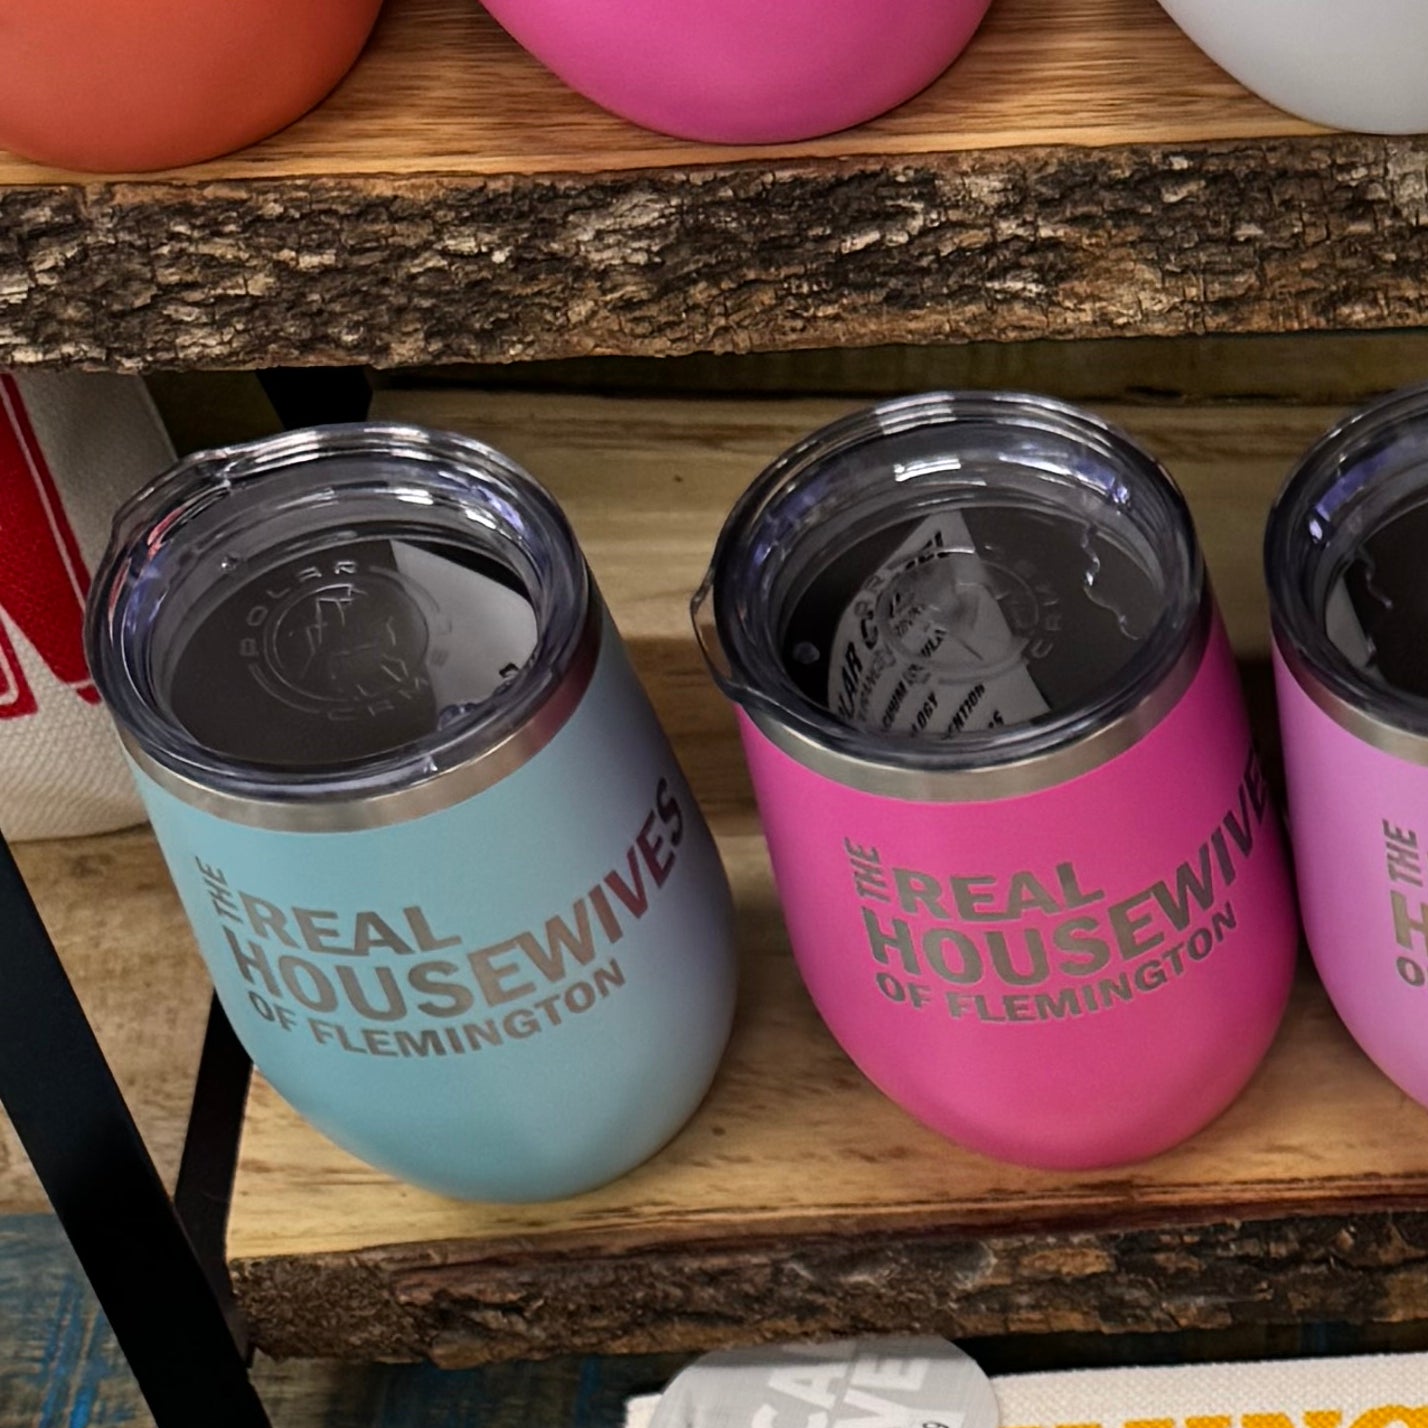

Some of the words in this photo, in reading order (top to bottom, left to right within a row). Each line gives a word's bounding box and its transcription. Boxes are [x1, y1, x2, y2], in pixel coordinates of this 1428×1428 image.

[844, 836, 891, 905] THE
[1381, 818, 1425, 888] THE
[195, 856, 228, 924] THE
[222, 776, 685, 1021] HOUSEWIVES
[237, 889, 462, 957] REAL
[890, 861, 1105, 923] REAL
[874, 971, 932, 1009] OF
[944, 901, 1238, 1024] FLEMINGTON
[249, 990, 298, 1033] OF
[306, 958, 627, 1058] FLEMINGTON
